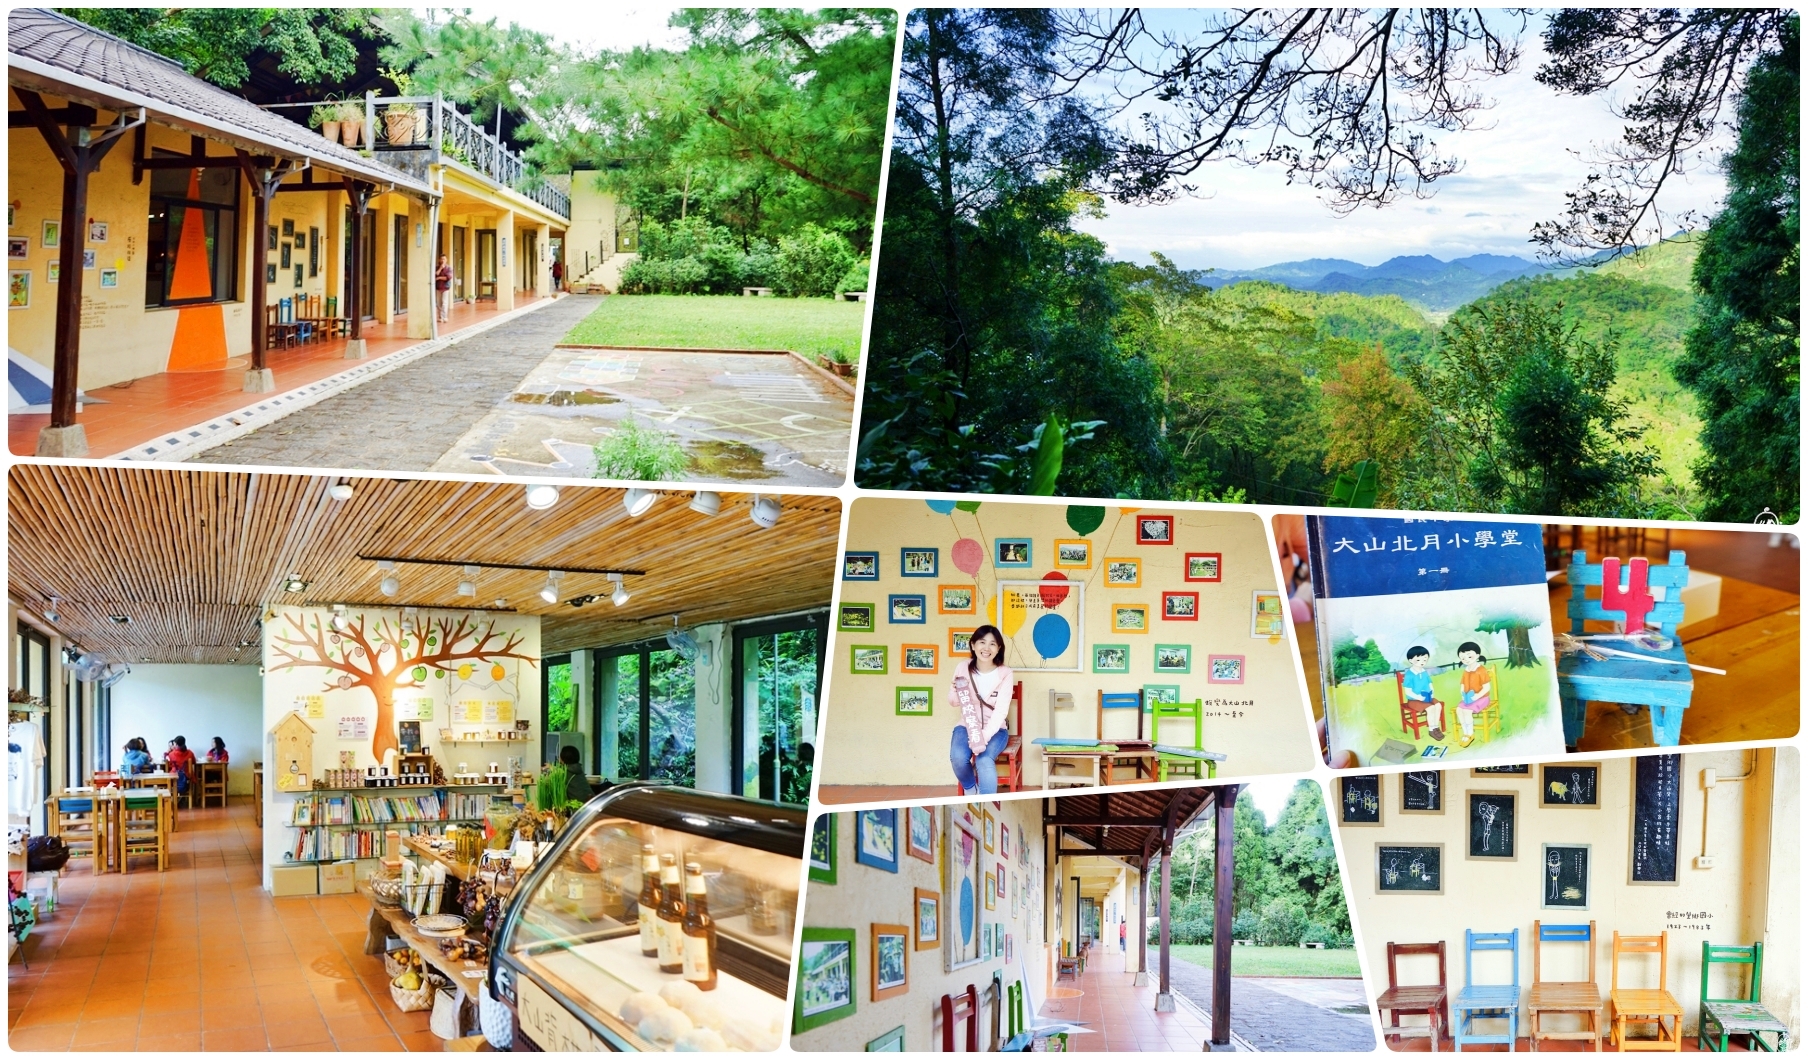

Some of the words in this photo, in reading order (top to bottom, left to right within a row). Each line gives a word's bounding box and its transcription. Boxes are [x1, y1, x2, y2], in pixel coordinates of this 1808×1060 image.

[1333, 529, 1523, 553] 大山北月小學堂
[1602, 557, 1654, 634] 4
